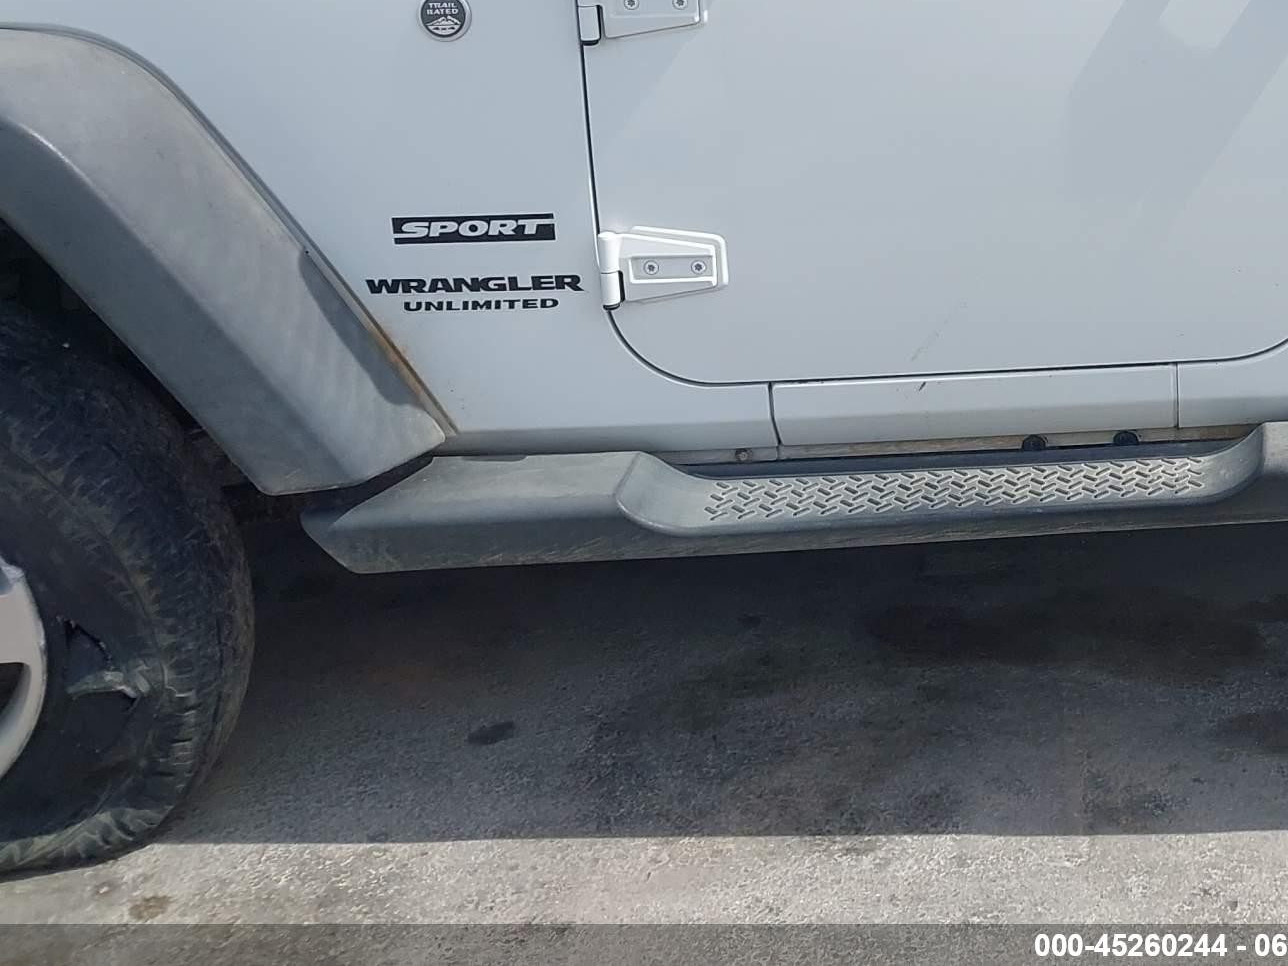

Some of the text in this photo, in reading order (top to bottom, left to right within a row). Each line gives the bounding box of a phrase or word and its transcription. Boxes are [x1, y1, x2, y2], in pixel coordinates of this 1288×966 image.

[393, 219, 554, 238] SPORT
[365, 274, 584, 294] WRANGLER
[403, 298, 559, 312] UNLIMITED
